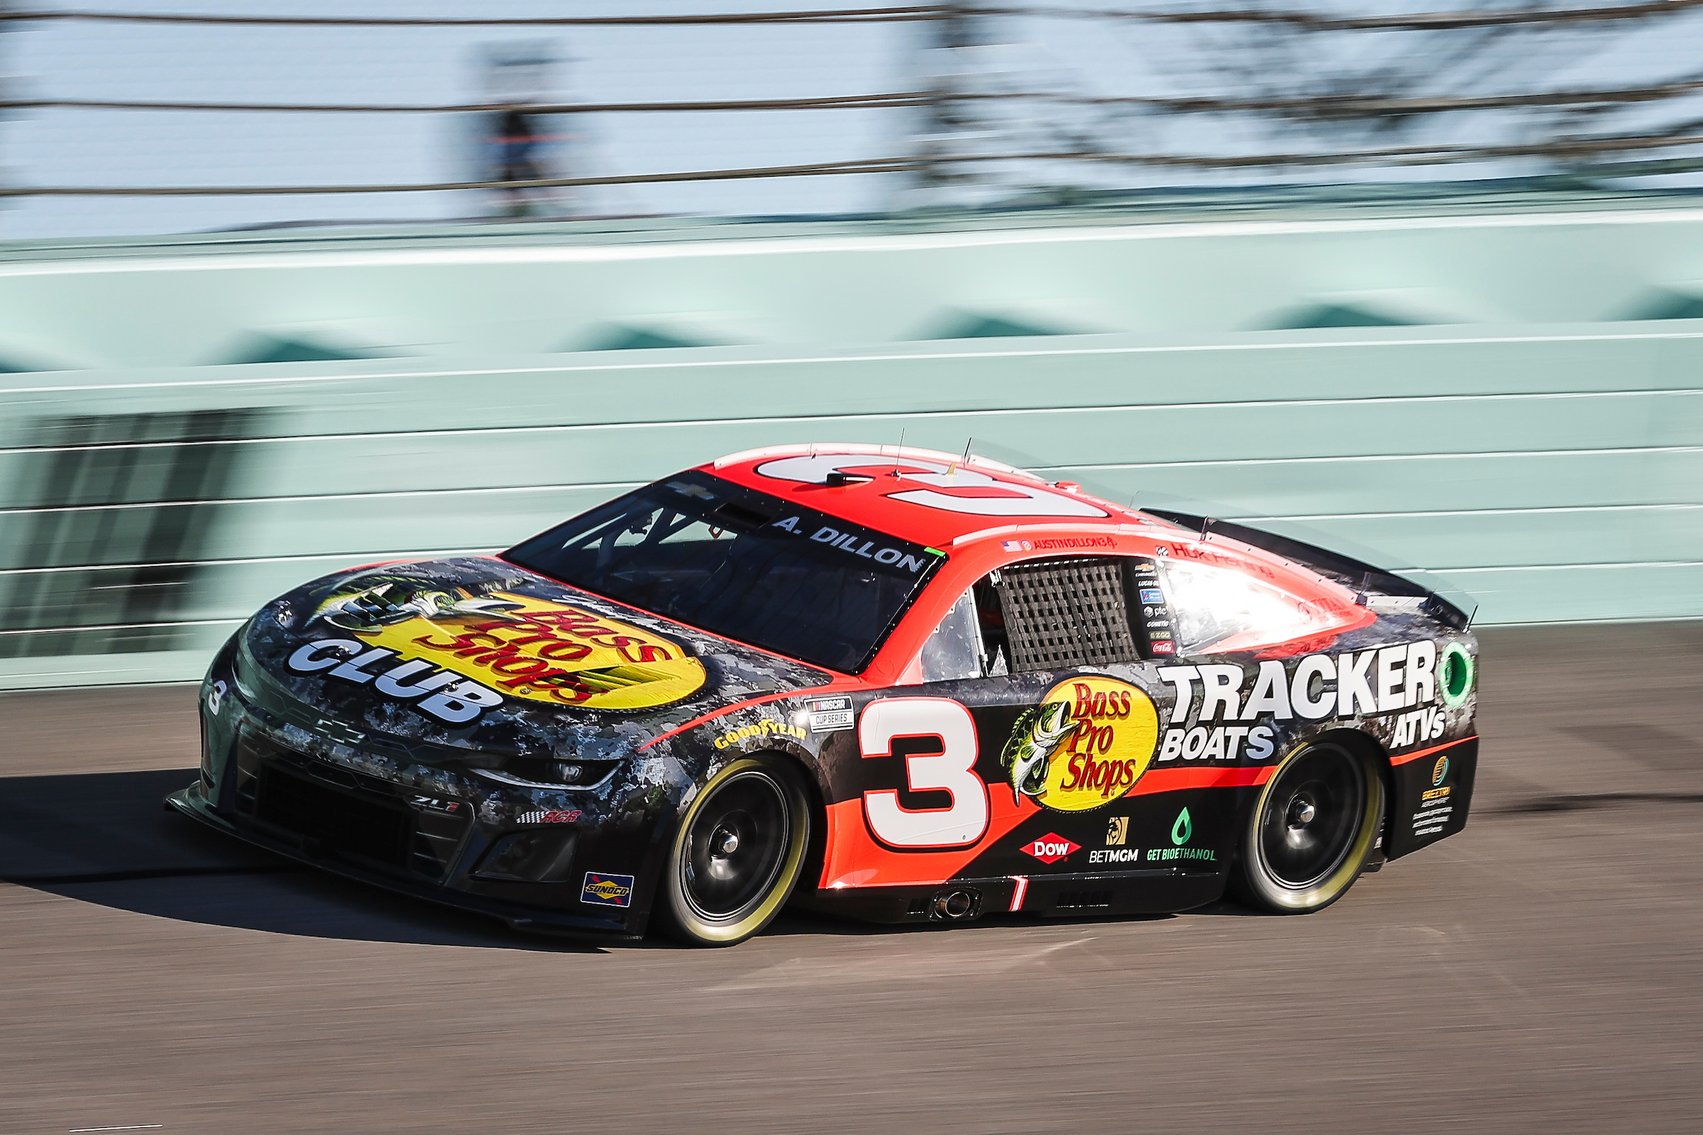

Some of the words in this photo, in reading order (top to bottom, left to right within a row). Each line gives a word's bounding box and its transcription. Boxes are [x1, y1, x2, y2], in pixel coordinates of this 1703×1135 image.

[772, 516, 803, 535] A.
[810, 526, 926, 573] DILLON
[464, 620, 593, 661] Pro
[289, 639, 504, 722] CLUB
[1157, 640, 1437, 722] TRACKER
[815, 714, 828, 725] CUP
[828, 712, 848, 723] SERIES
[819, 699, 846, 711] NASCAR
[1071, 683, 1132, 718] Bass
[714, 718, 807, 749] GOODYEAR
[1066, 719, 1114, 754] Pro
[1158, 726, 1275, 763] BOATS
[1389, 706, 1447, 749] ATVs
[860, 698, 990, 848] 3
[1060, 753, 1137, 796] Shops
[1089, 849, 1139, 864] BETMGM
[1146, 849, 1162, 861] GET
[1163, 848, 1217, 861] BIOETHANOL
[587, 884, 628, 896] SUNOCO
